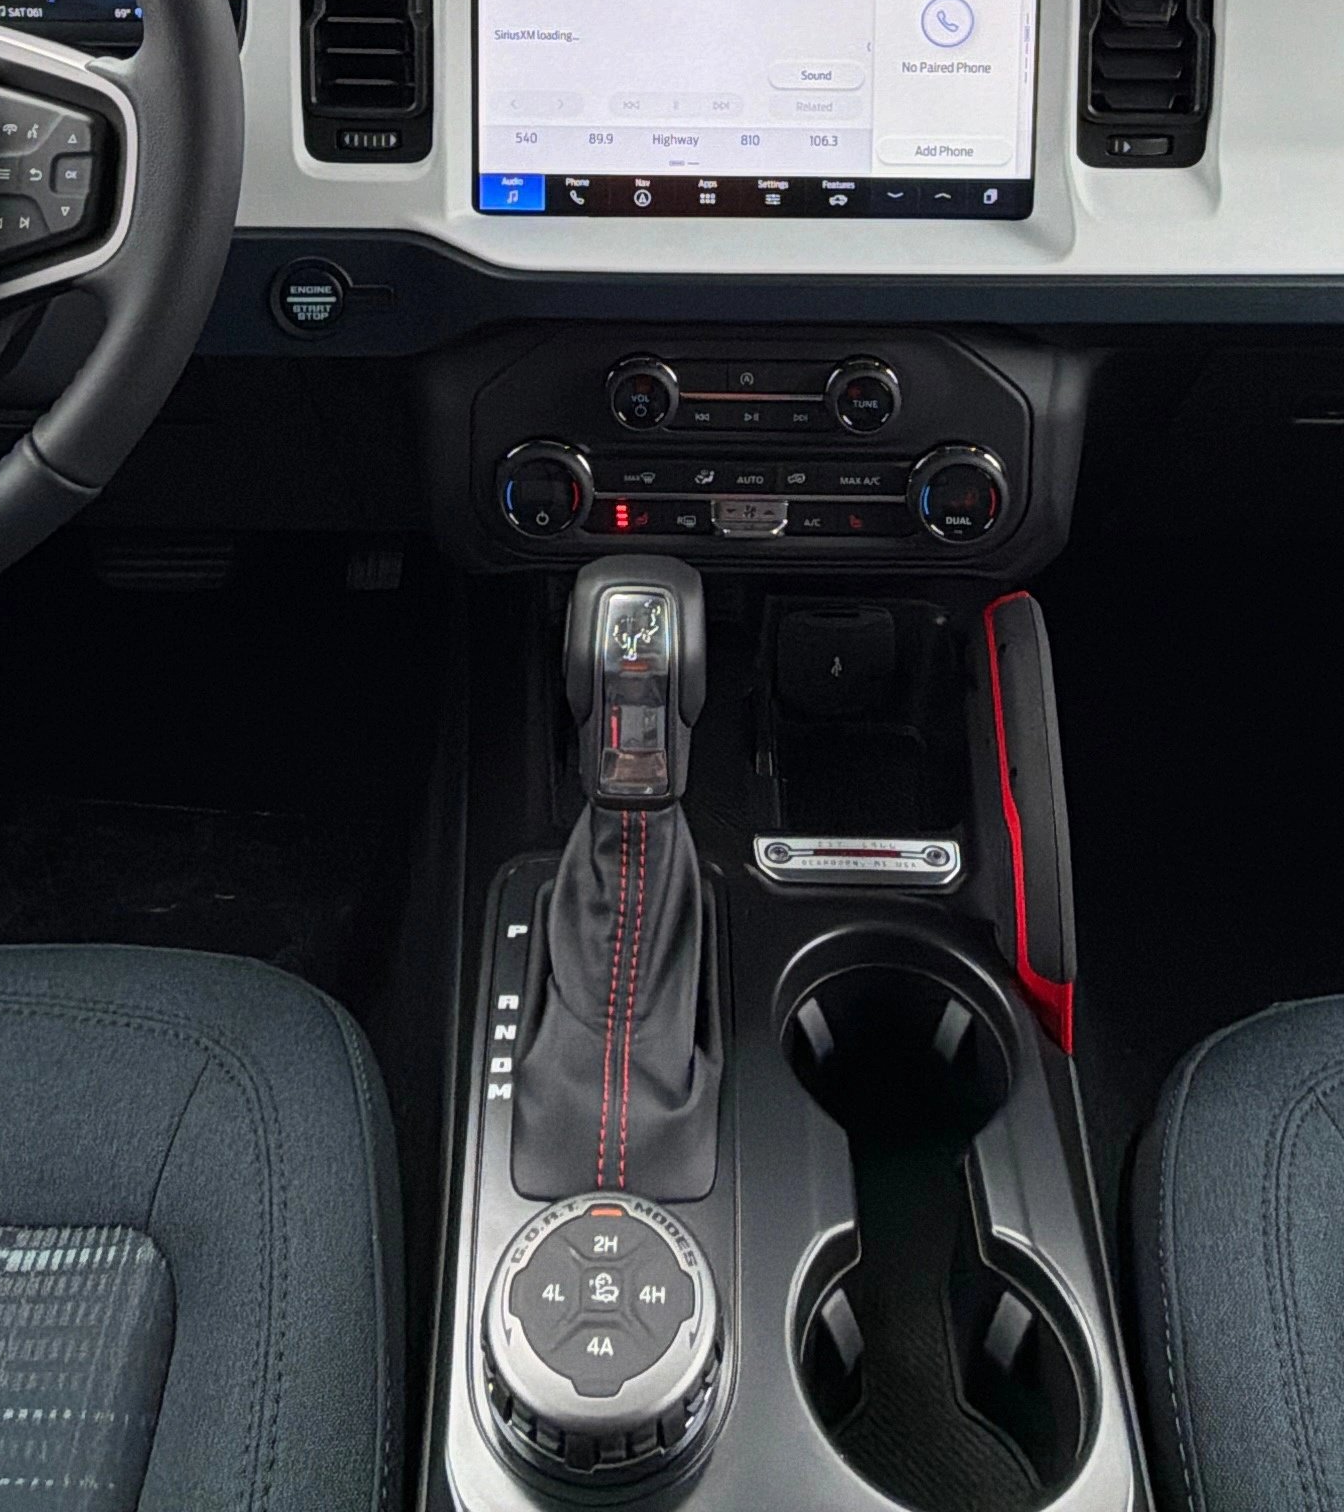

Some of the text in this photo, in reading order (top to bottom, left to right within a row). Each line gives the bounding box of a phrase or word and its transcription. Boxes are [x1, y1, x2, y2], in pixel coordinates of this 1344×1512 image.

[8, 7, 43, 18] SAT 061
[494, 30, 536, 41] SiriusXM
[902, 62, 992, 74] No Paired Phone
[801, 70, 832, 81] Sound
[796, 101, 833, 112] Related
[515, 132, 538, 144] 540
[588, 133, 614, 145] 89.9
[652, 134, 699, 148] Highway
[740, 134, 760, 146] 810
[810, 135, 838, 147] 106.3
[915, 145, 974, 157] Add Phone
[501, 177, 524, 186] Audio
[565, 177, 590, 187] Phone
[635, 178, 651, 187] Nav
[698, 178, 717, 189] Apps
[758, 180, 789, 190] Settings
[822, 180, 855, 189] Features
[290, 286, 333, 294] ENGINE
[293, 304, 332, 313] START
[298, 312, 329, 320] STOP
[631, 395, 650, 403] VOL
[853, 400, 878, 408] TUNE
[736, 476, 764, 484] AUTO
[840, 476, 881, 485] MAX A/C
[804, 519, 821, 527] A/C
[946, 517, 972, 525] DUAL
[507, 925, 528, 938] P
[494, 1025, 517, 1040] N
[490, 1057, 512, 1073] D
[487, 1084, 512, 1100] M
[634, 1202, 698, 1268] MODES
[594, 1236, 618, 1253] 2H
[542, 1284, 666, 1305] 4L 4H
[587, 1337, 614, 1356] 4A
